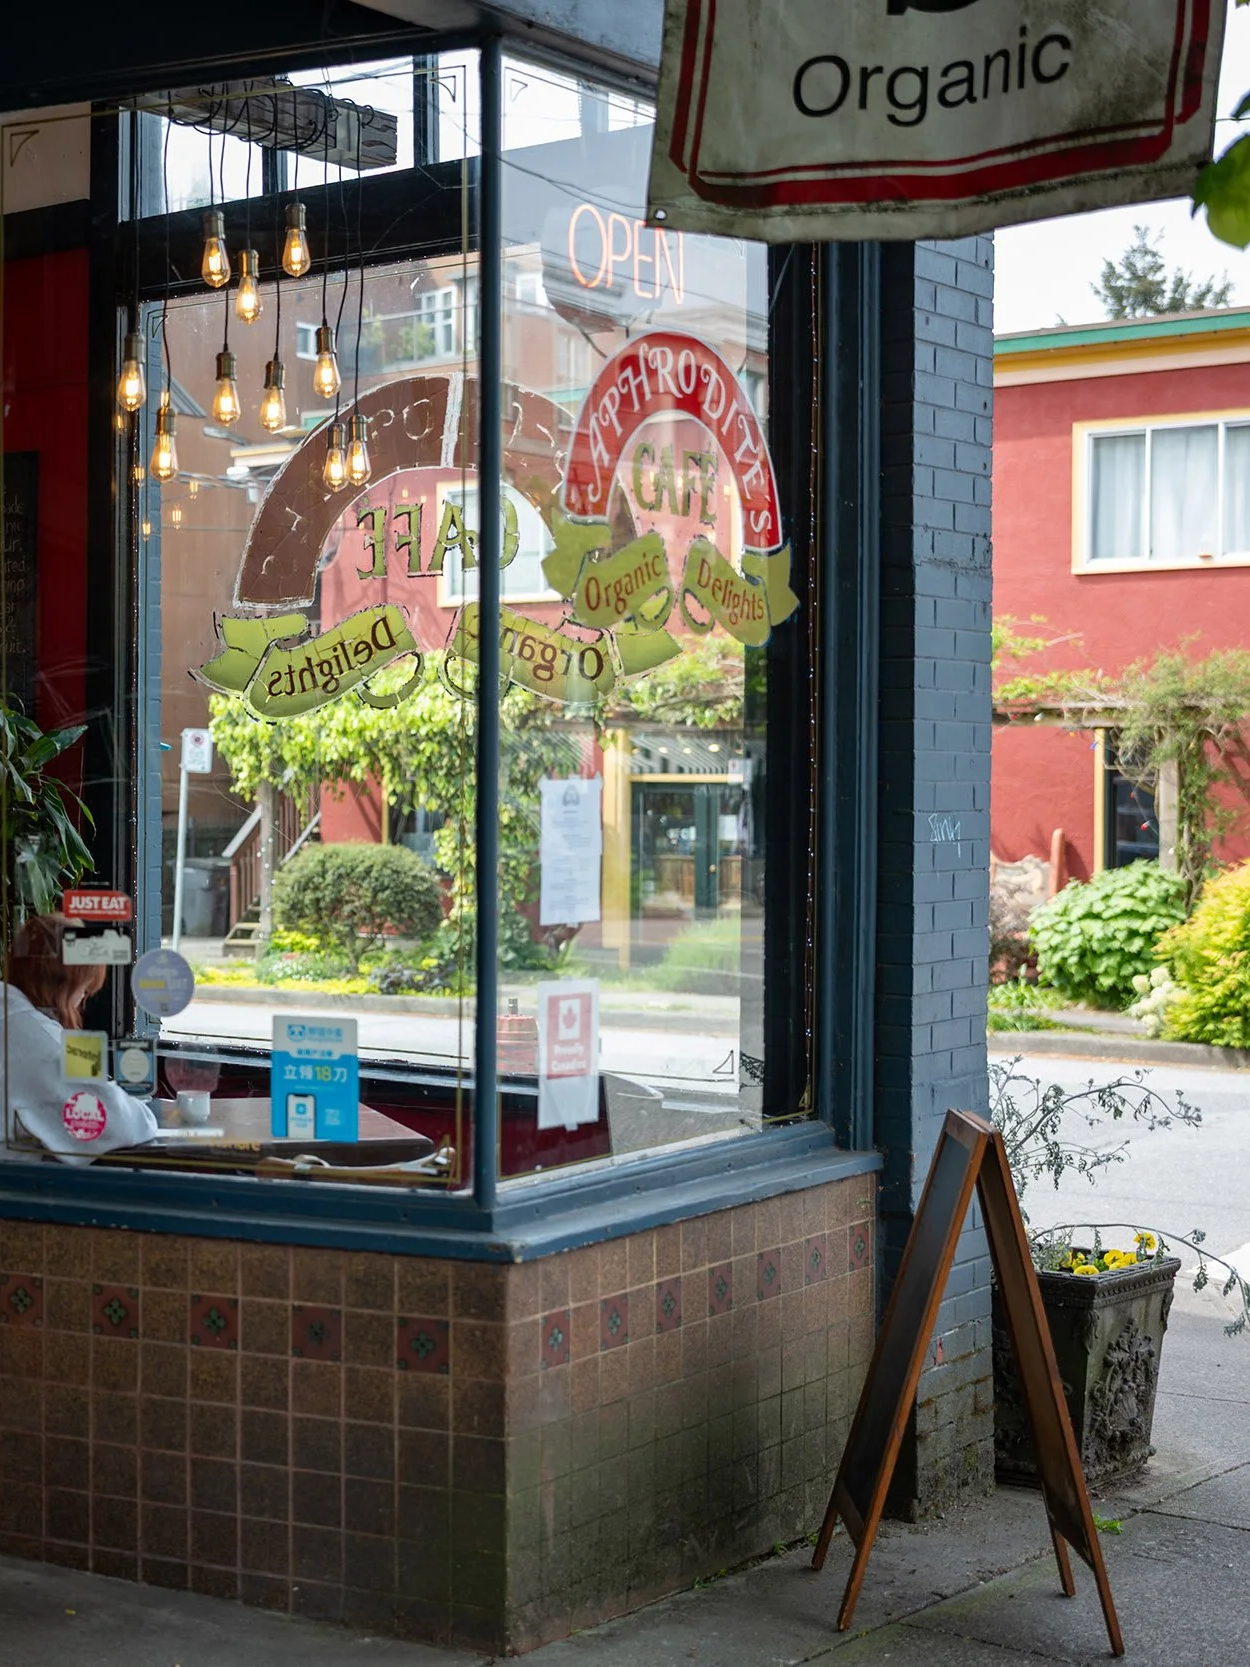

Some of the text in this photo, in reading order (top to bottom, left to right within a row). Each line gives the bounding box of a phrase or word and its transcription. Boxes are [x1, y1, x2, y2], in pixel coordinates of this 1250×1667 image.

[793, 25, 1072, 127] Organic
[568, 203, 684, 305] OPEN
[587, 342, 772, 534] APHRODITE'S
[585, 552, 765, 625] Organic Delights
[69, 895, 127, 911] JUST EAT
